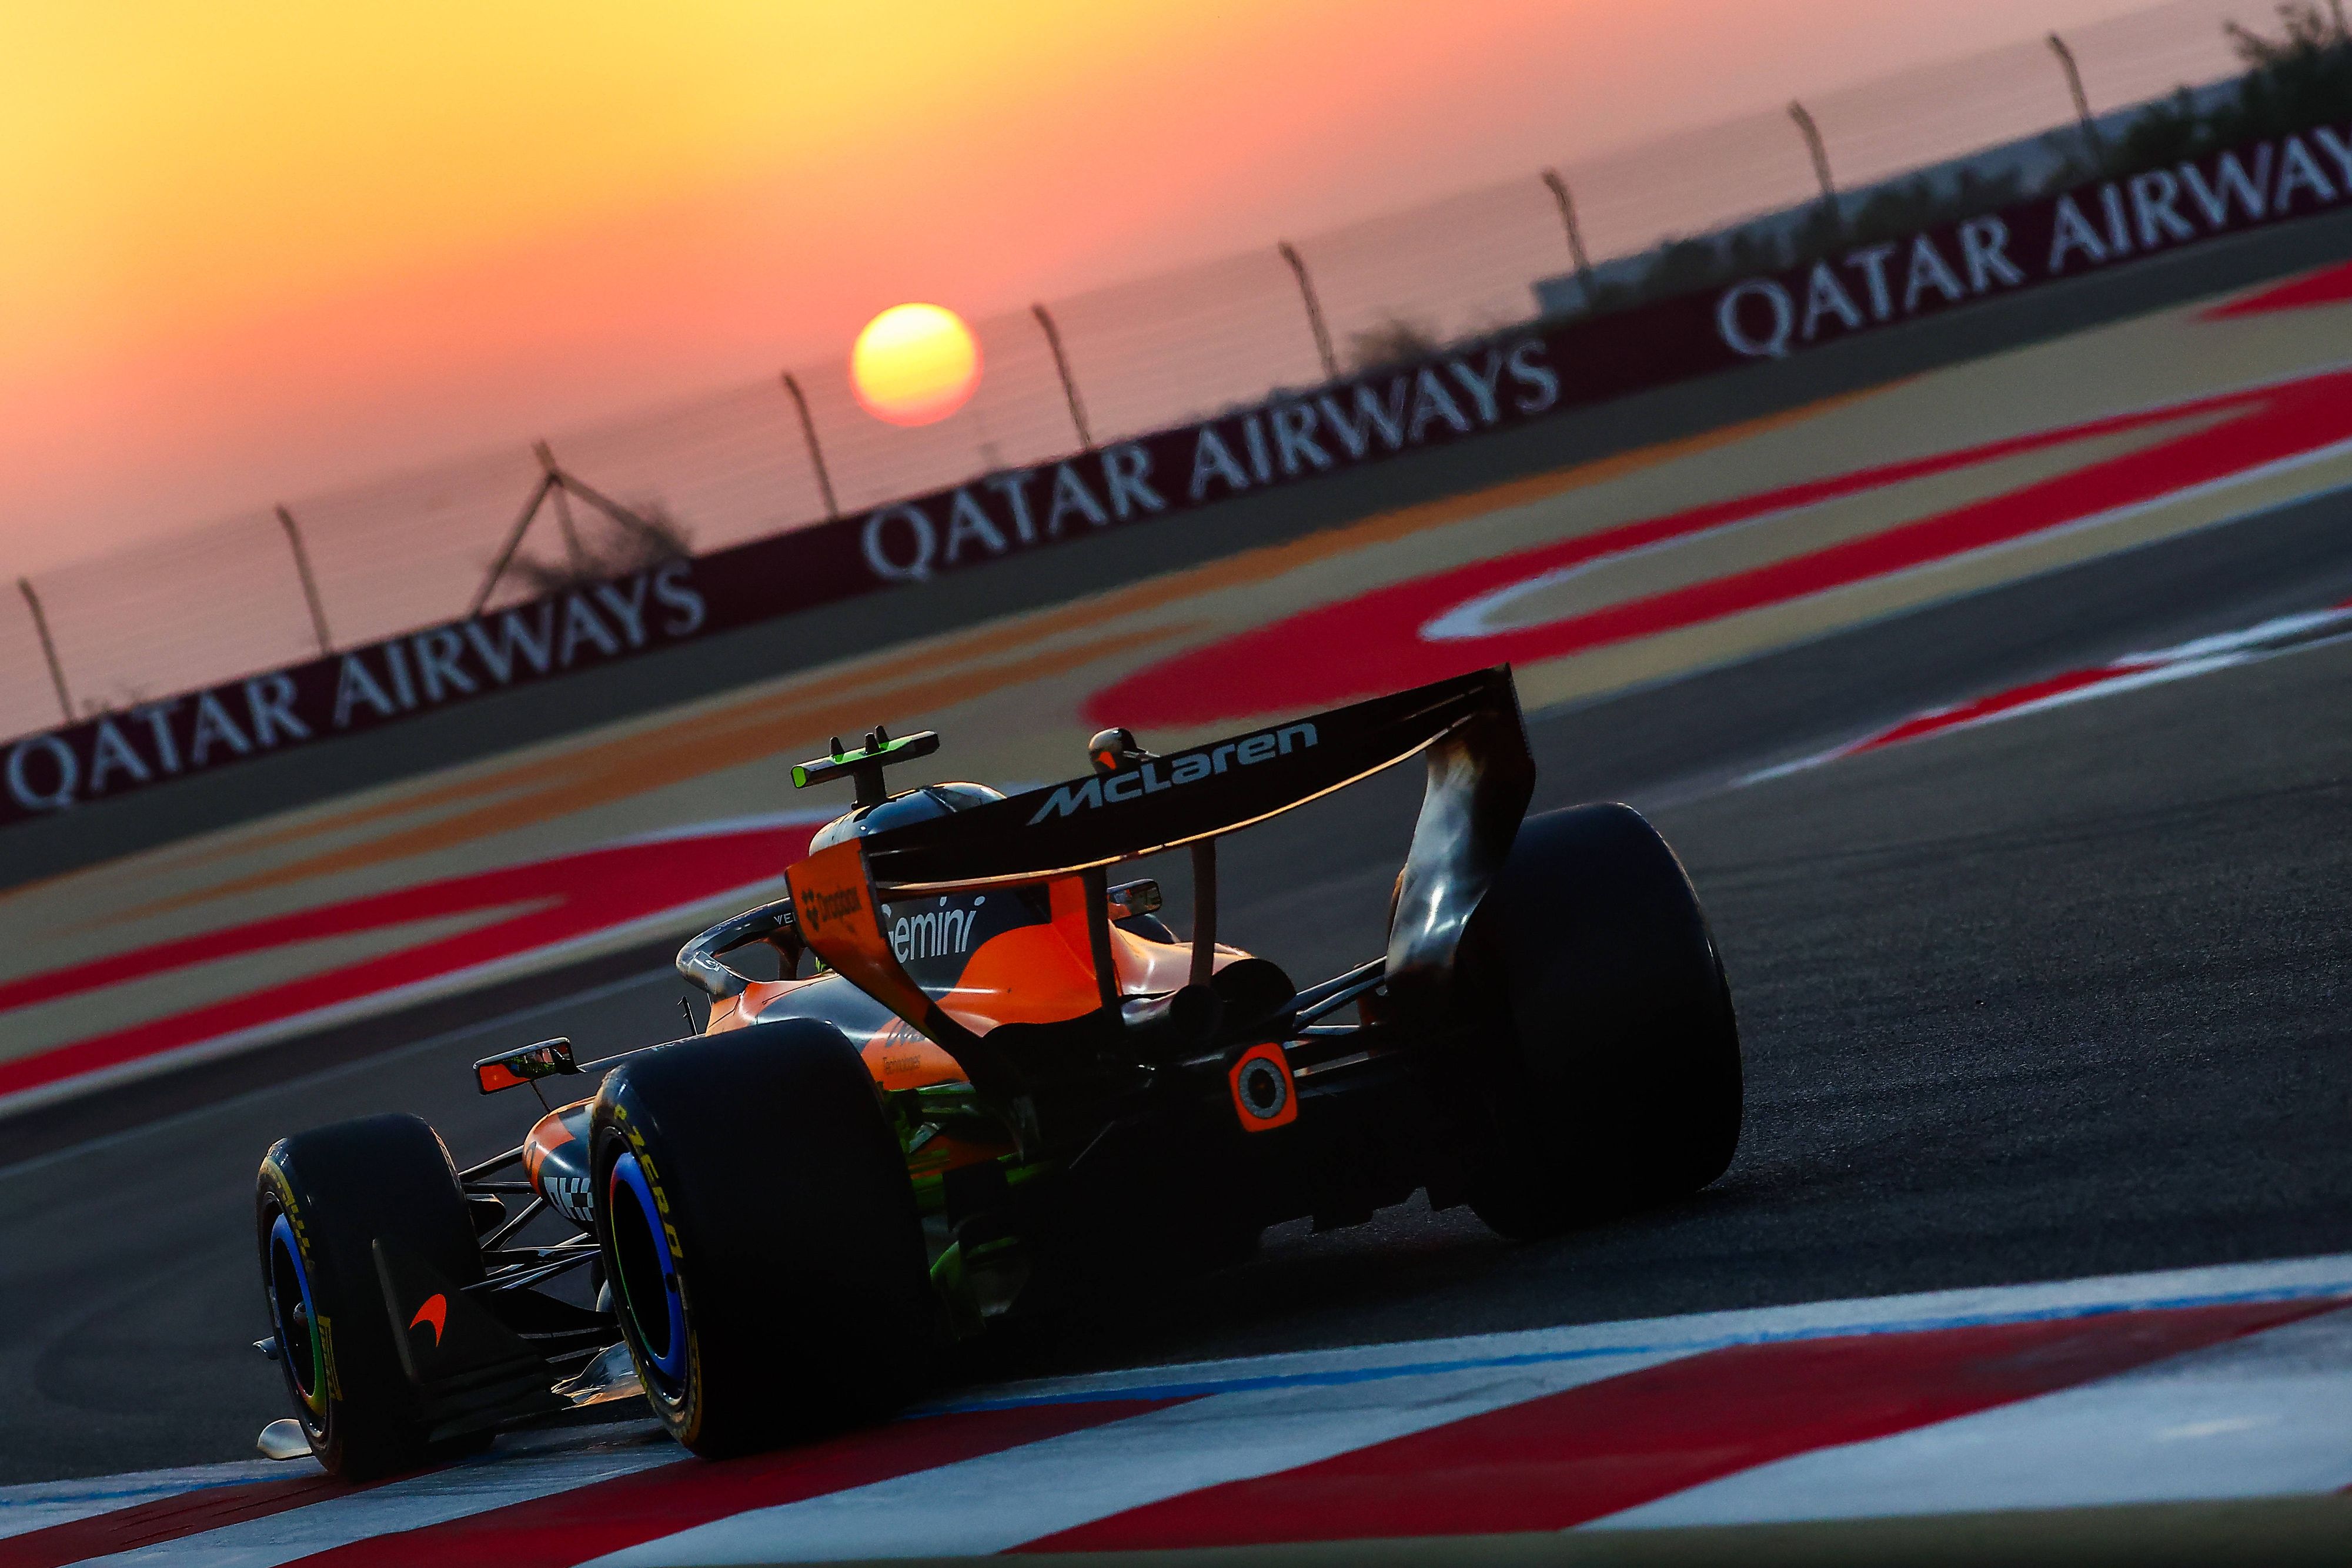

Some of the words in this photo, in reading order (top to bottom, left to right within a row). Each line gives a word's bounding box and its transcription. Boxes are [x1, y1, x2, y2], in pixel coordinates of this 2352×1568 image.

[1713, 212, 2027, 359] QATAR
[860, 442, 1169, 583] QATAR
[1188, 339, 1559, 501] AIRWAYS
[4, 671, 315, 810] QATAR
[332, 557, 707, 729] AIRWAYS
[1025, 721, 1319, 827] McLaren
[773, 911, 796, 925] VE
